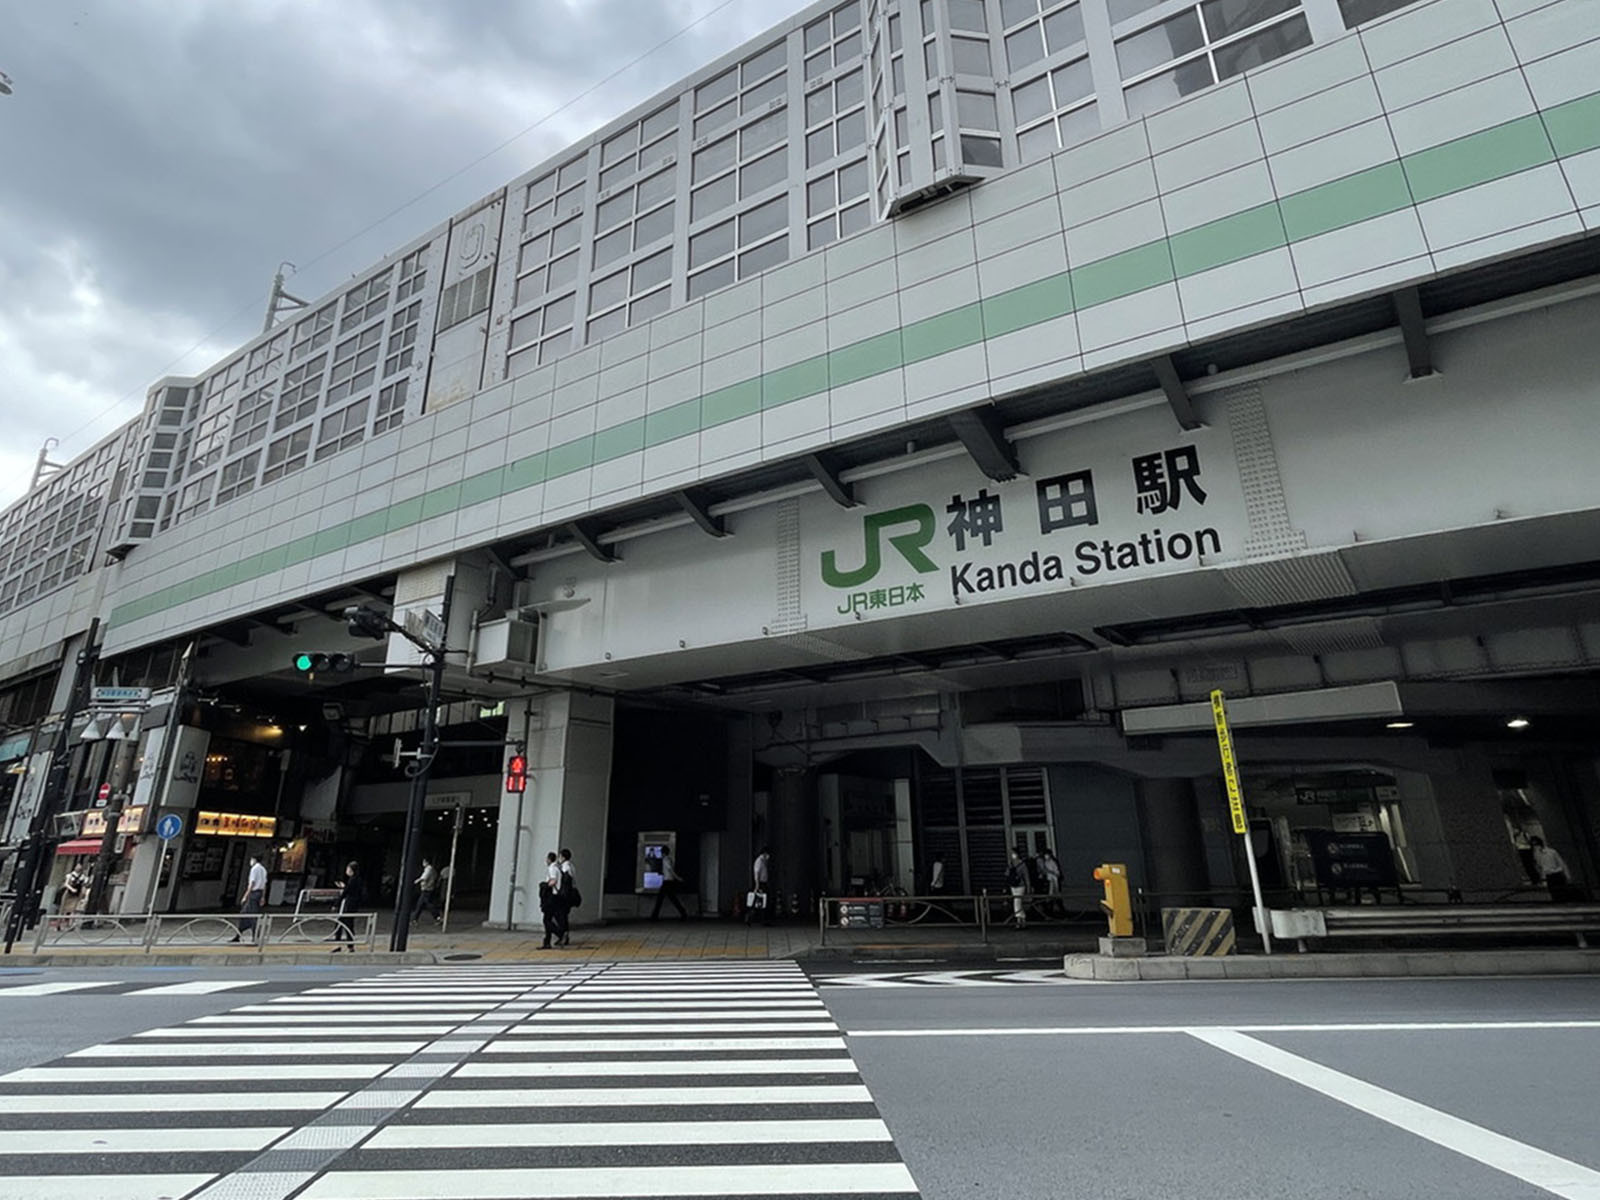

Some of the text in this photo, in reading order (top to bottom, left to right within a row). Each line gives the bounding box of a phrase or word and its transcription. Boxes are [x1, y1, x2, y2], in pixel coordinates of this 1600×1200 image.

[946, 445, 1207, 552] 神田駅
[821, 503, 940, 588] JR
[951, 527, 1222, 597] Kanda Station
[838, 583, 926, 614] JR東日本
